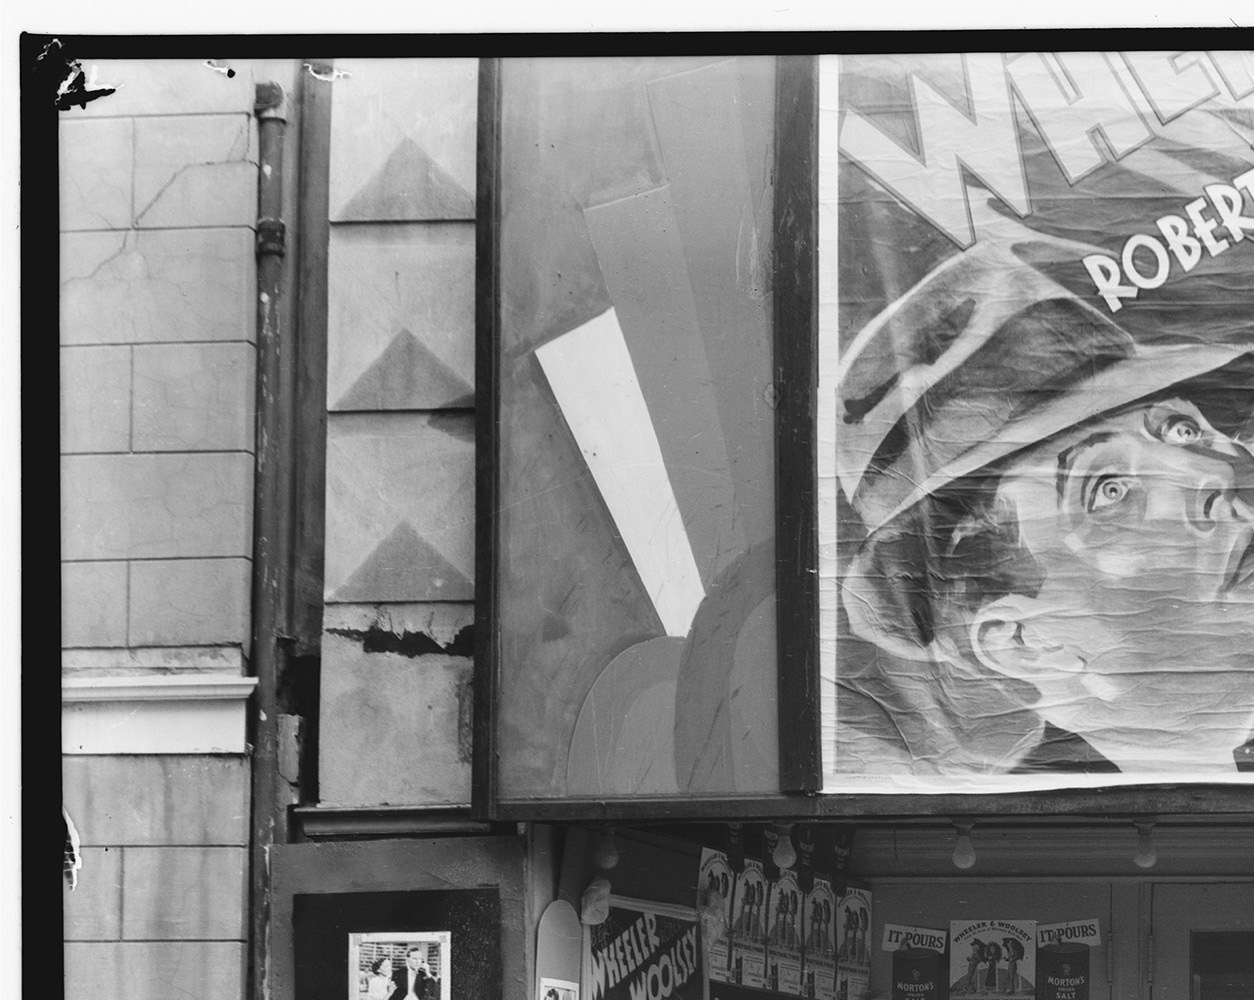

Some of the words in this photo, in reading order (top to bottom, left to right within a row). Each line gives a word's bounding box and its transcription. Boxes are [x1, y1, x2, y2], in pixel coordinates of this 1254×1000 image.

[888, 929, 903, 943] IT
[904, 931, 944, 949] POURS
[953, 921, 987, 943] WHEELER
[997, 920, 1032, 942] WOOLSEY
[1039, 930, 1053, 943] IT
[1056, 924, 1097, 942] POURS
[897, 980, 934, 992] MORTON'S
[1047, 974, 1085, 986] MORTON'S
[1055, 991, 1077, 1000] SALT
